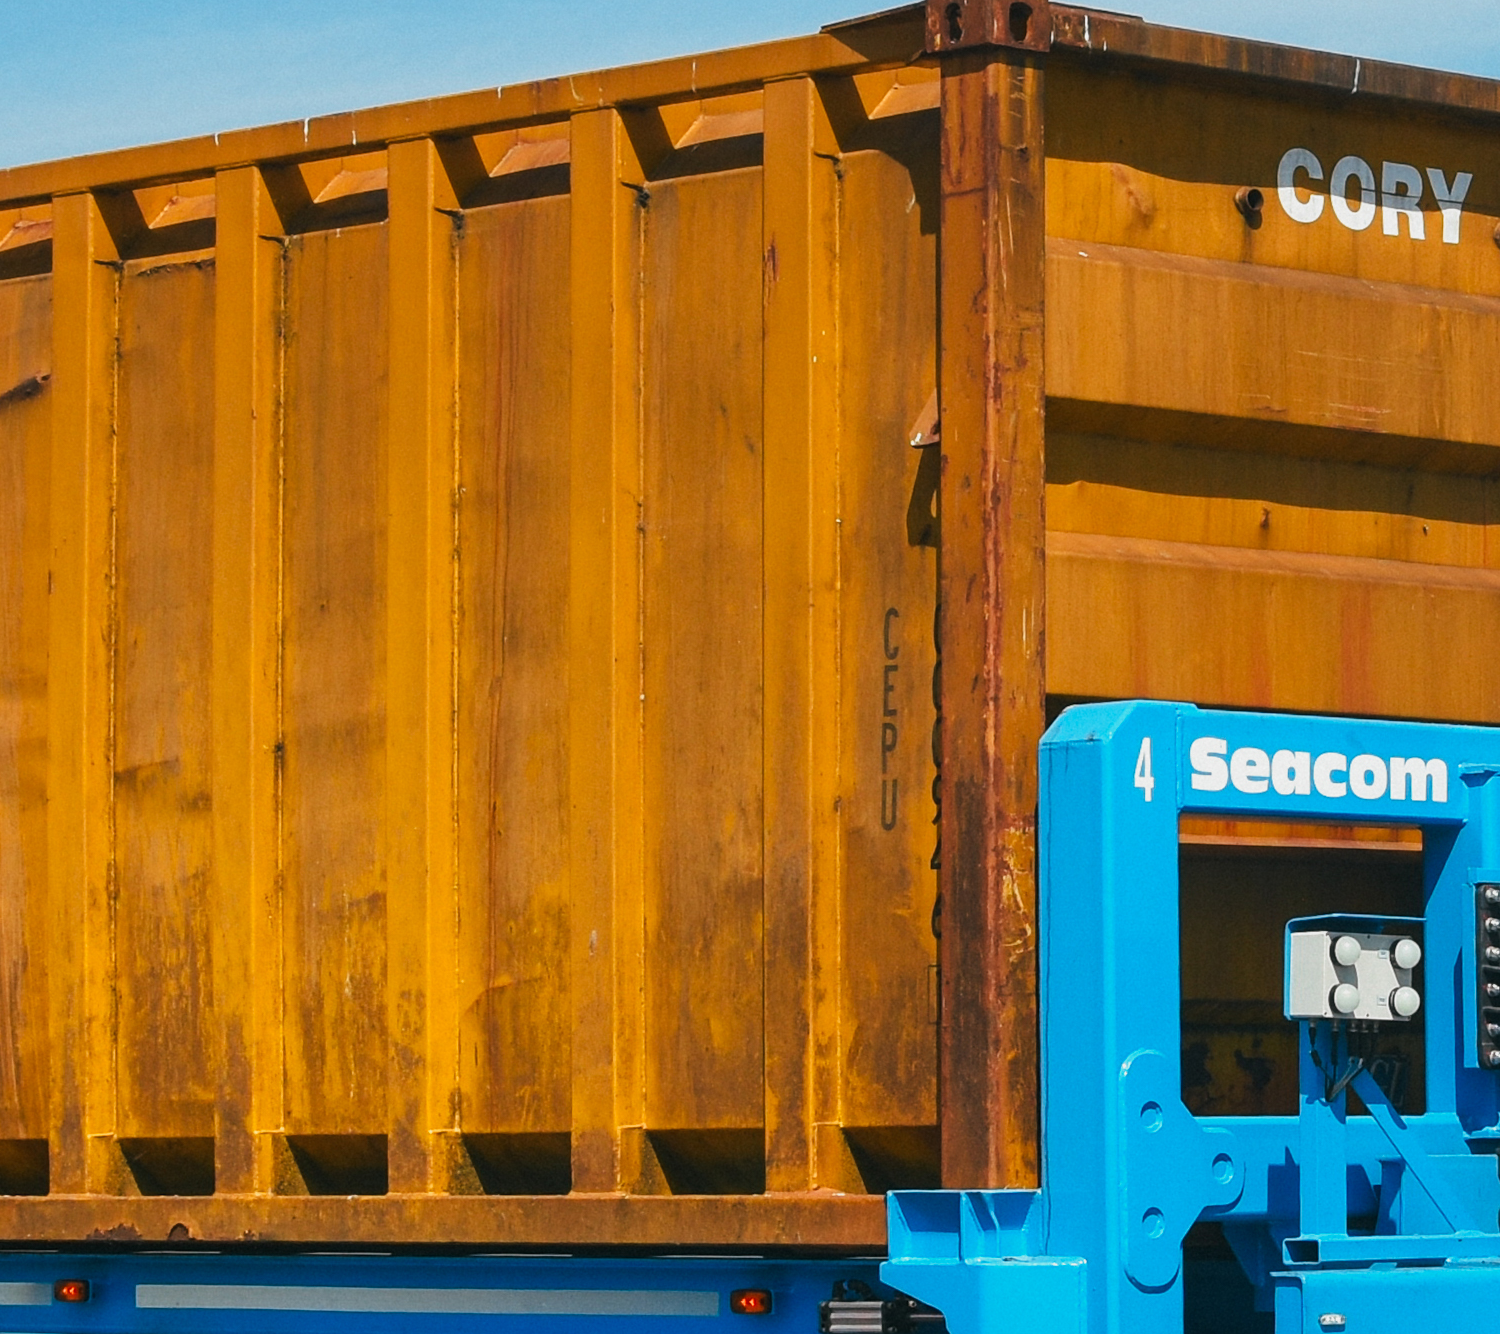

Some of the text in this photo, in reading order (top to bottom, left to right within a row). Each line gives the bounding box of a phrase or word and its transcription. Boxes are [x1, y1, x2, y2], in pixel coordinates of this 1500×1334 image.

[1275, 147, 1474, 245] CORY
[880, 607, 900, 831] CEPU
[1133, 736, 1155, 803] 4
[1189, 737, 1448, 803] Seacom
